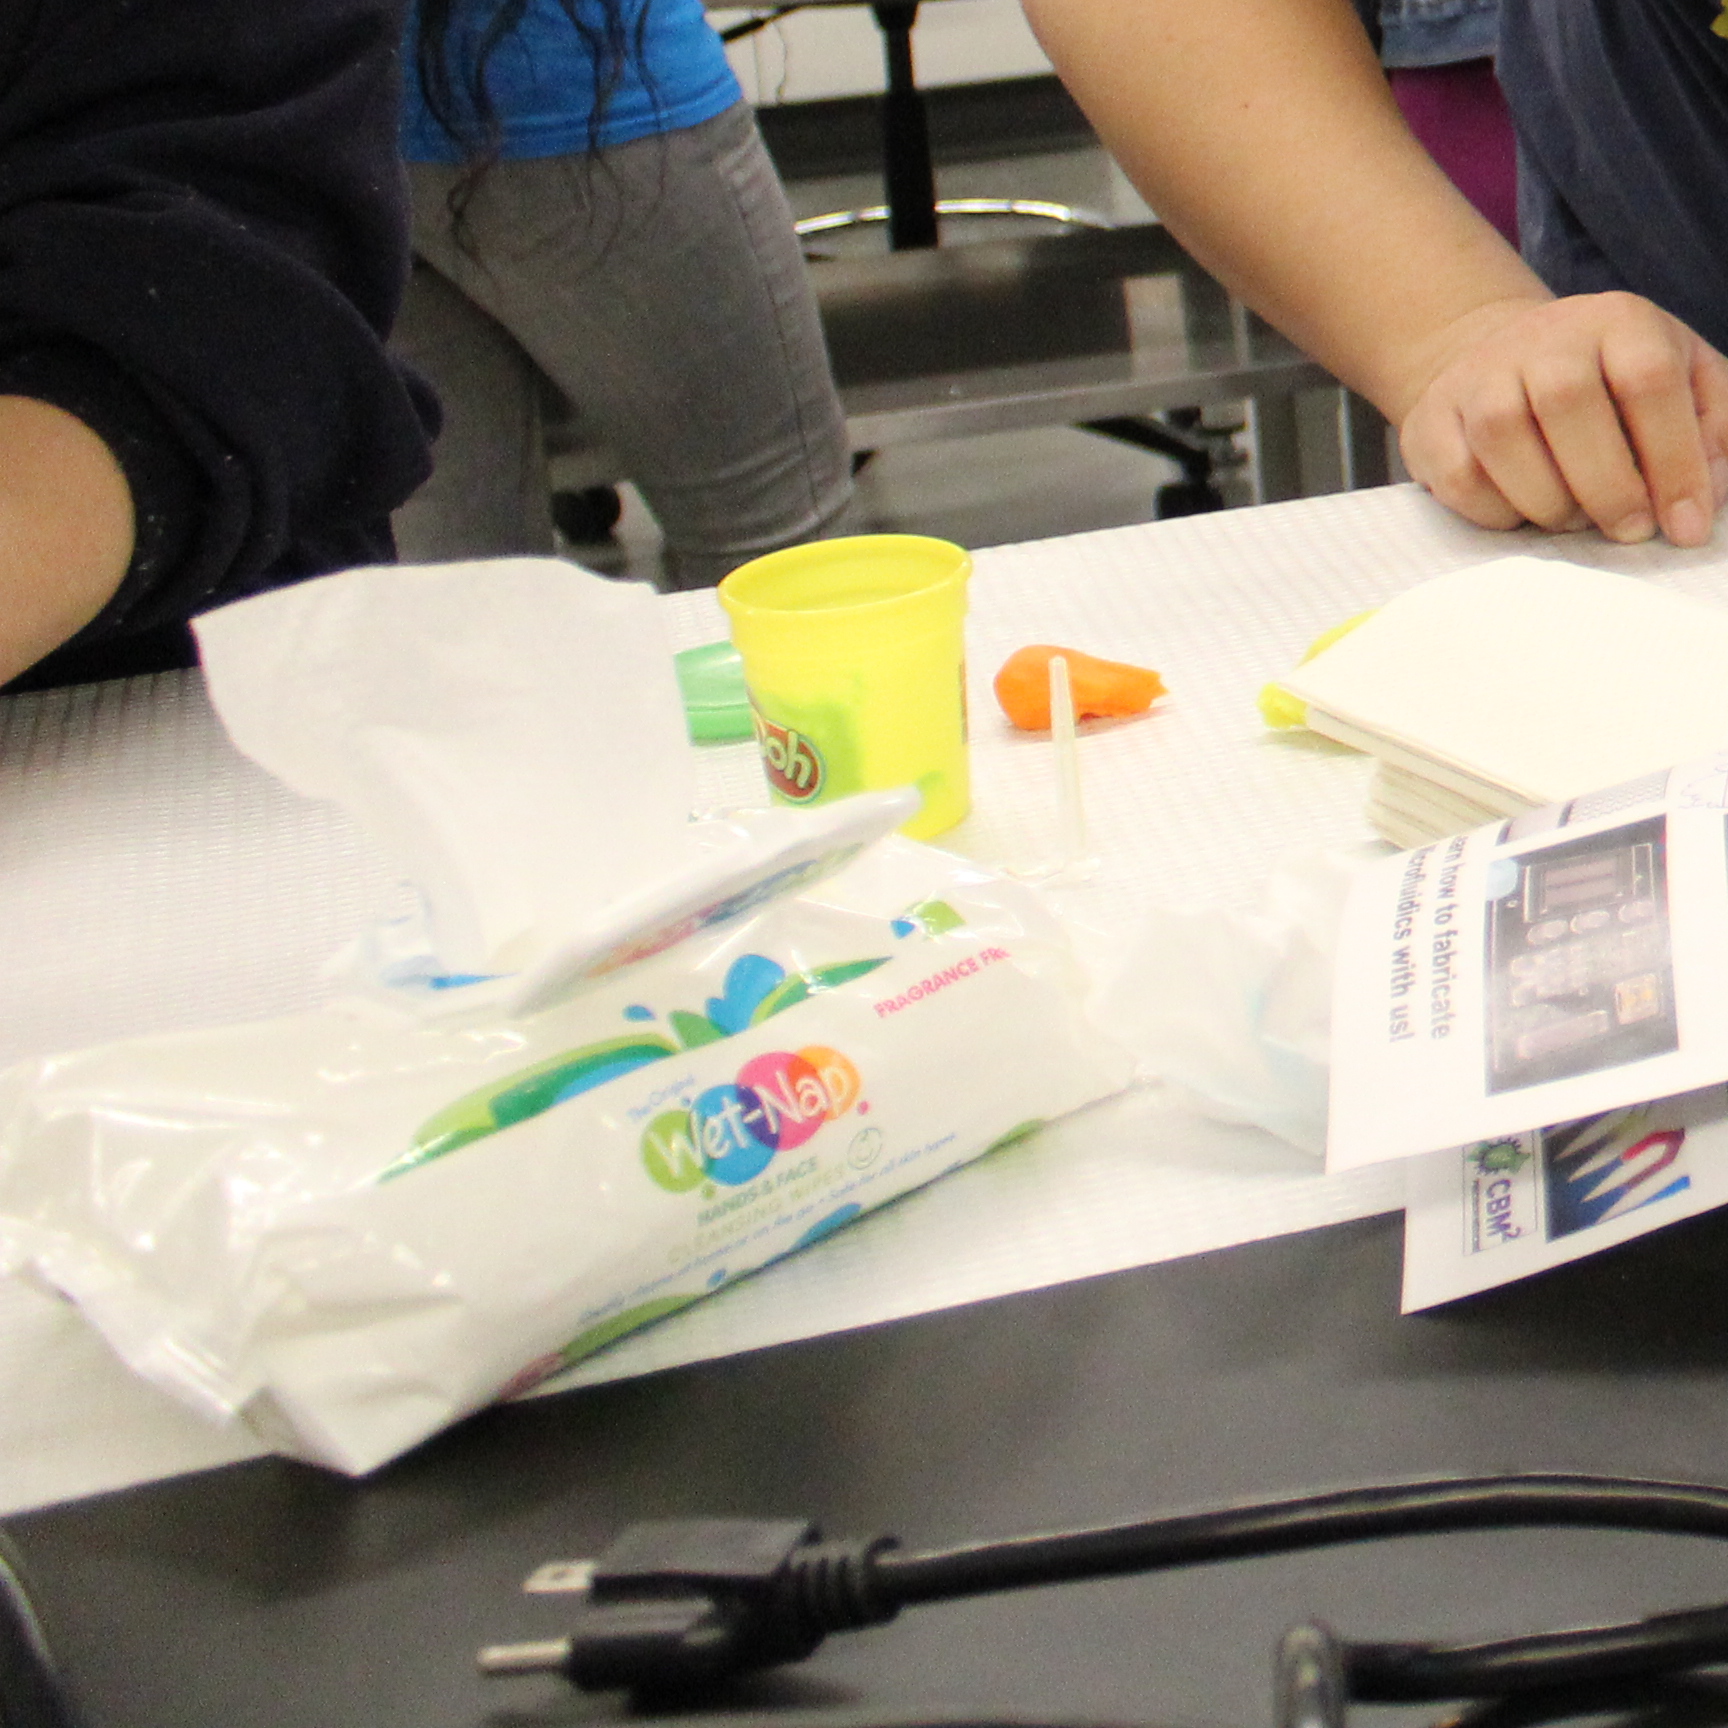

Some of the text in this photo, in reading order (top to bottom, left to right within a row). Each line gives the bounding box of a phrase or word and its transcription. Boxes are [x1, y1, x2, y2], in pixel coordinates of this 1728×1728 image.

[1390, 946, 1416, 999] with
[1430, 835, 1468, 1041] earn how to fabricate
[873, 947, 1012, 1019] FRAGRANCE FR
[1389, 1004, 1415, 1043] us!
[643, 1067, 853, 1178] Wet-Nap
[697, 1186, 761, 1225] HANDS
[776, 1156, 819, 1189] FACE
